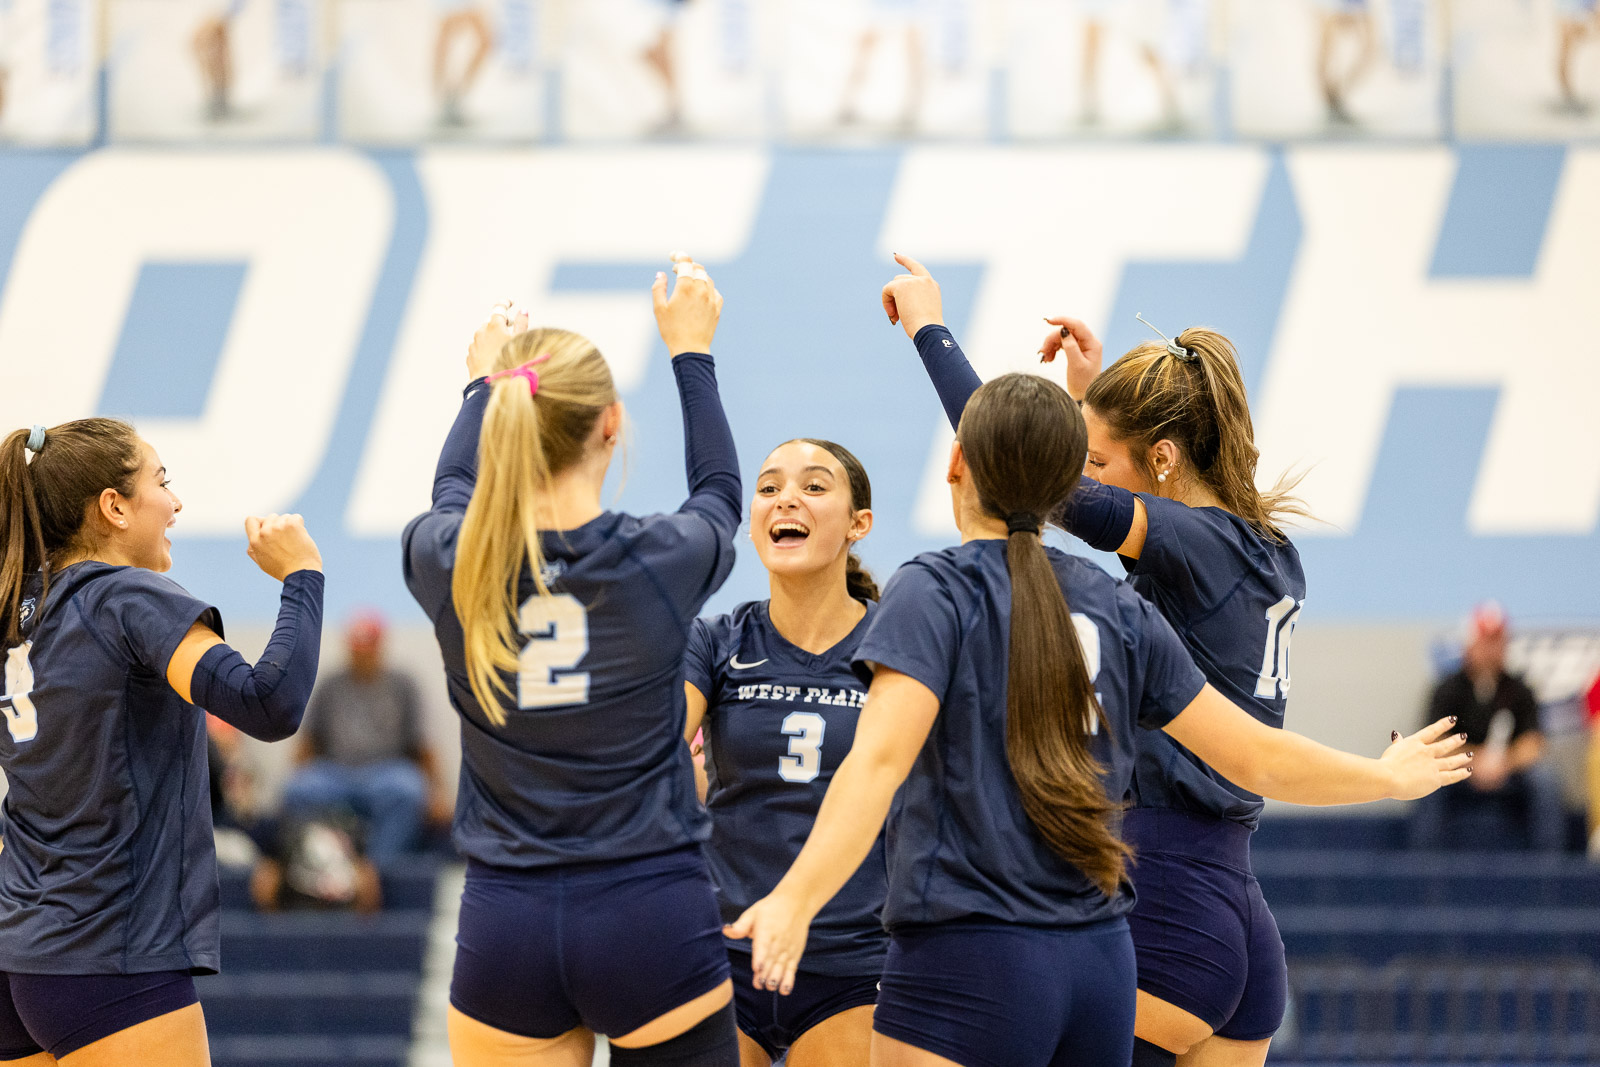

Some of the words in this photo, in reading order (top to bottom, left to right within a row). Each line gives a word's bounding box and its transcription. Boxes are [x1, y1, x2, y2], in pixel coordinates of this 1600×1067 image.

[0, 147, 771, 536] OF
[516, 592, 591, 710] 2
[738, 684, 801, 702] WEST
[778, 711, 827, 784] 3
